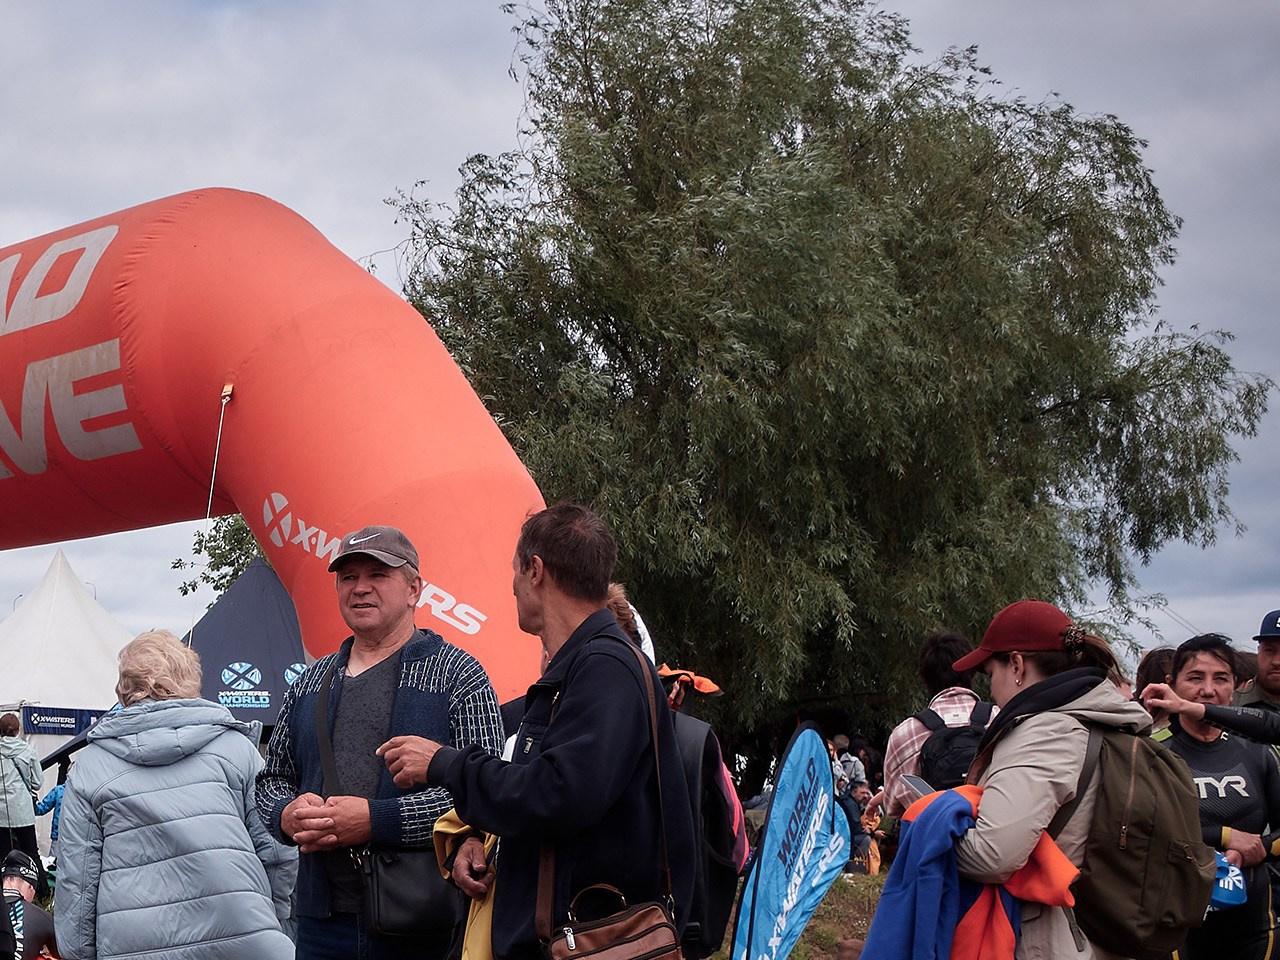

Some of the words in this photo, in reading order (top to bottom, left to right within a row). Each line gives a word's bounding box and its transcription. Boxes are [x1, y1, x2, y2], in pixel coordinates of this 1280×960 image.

[218, 695, 270, 704] WORLD
[1193, 775, 1250, 799] TYR
[777, 757, 816, 867] WORLD
